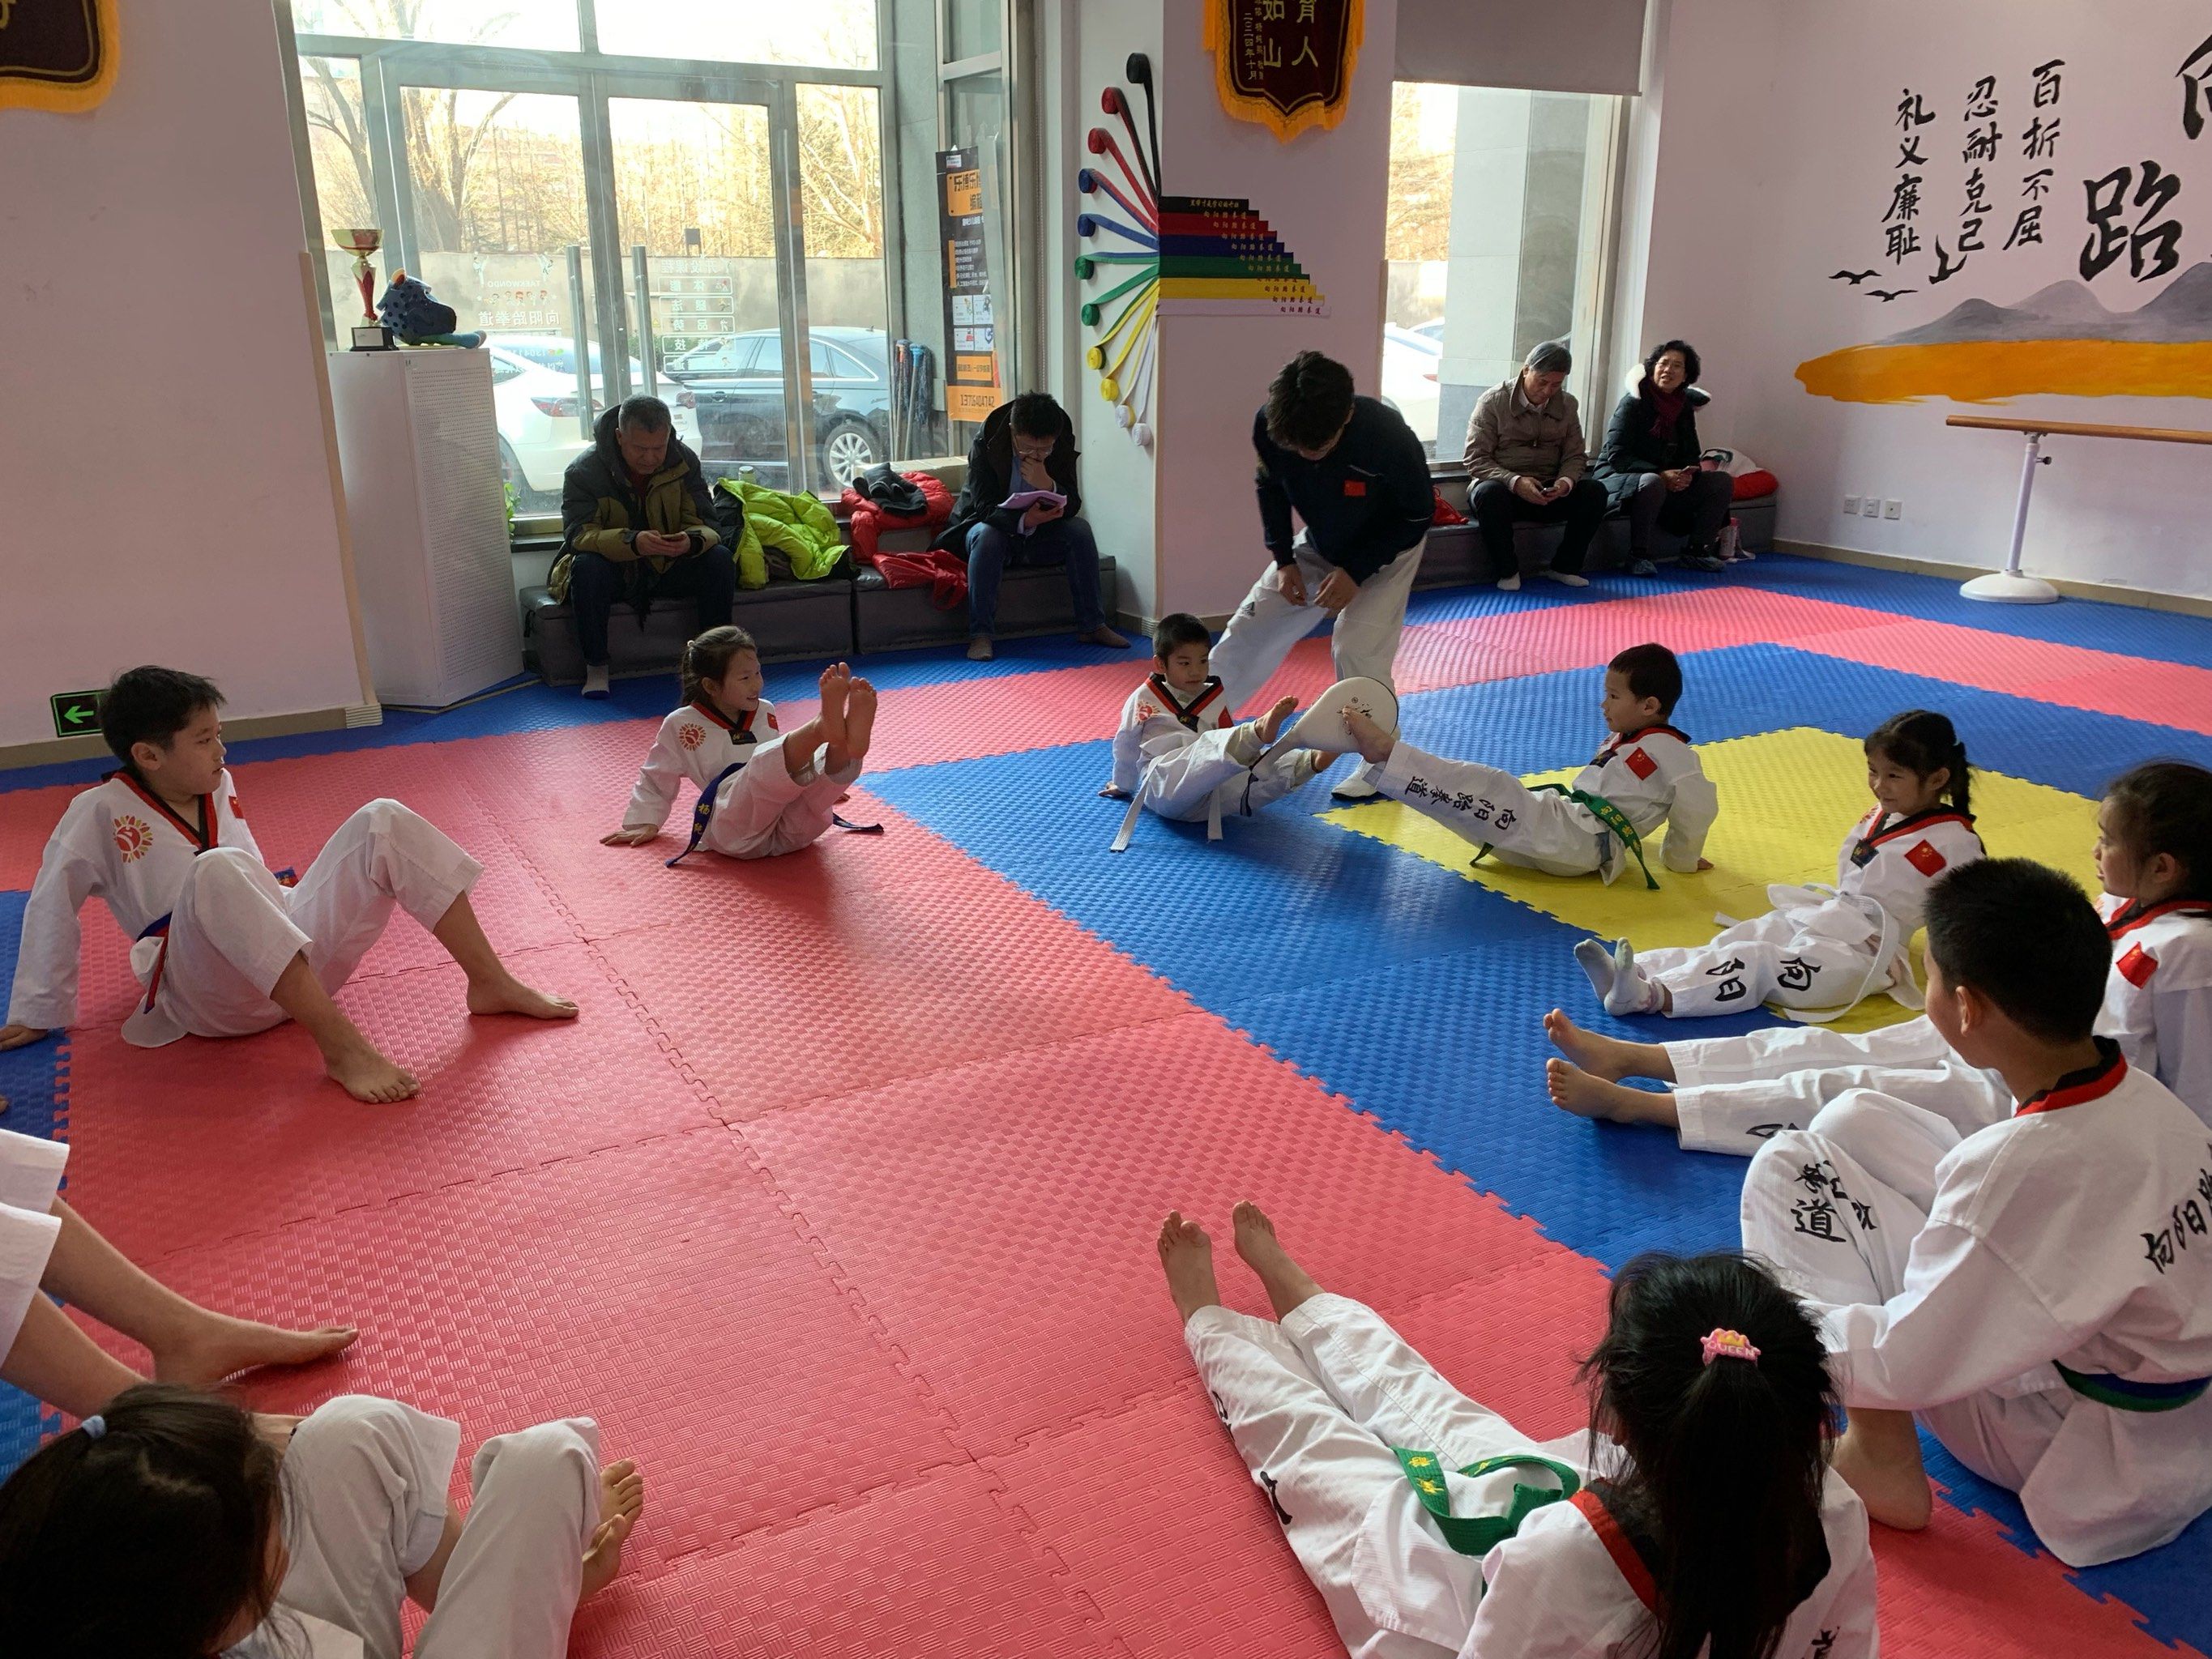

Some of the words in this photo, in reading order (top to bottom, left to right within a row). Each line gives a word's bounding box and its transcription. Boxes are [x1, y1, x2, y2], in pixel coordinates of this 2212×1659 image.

[1881, 88, 1937, 265] 礼义廉耻
[1958, 75, 2002, 252] 忍耐克己
[2002, 58, 2065, 251] 百折不屈
[1706, 1341, 1755, 1357] QUEEN
